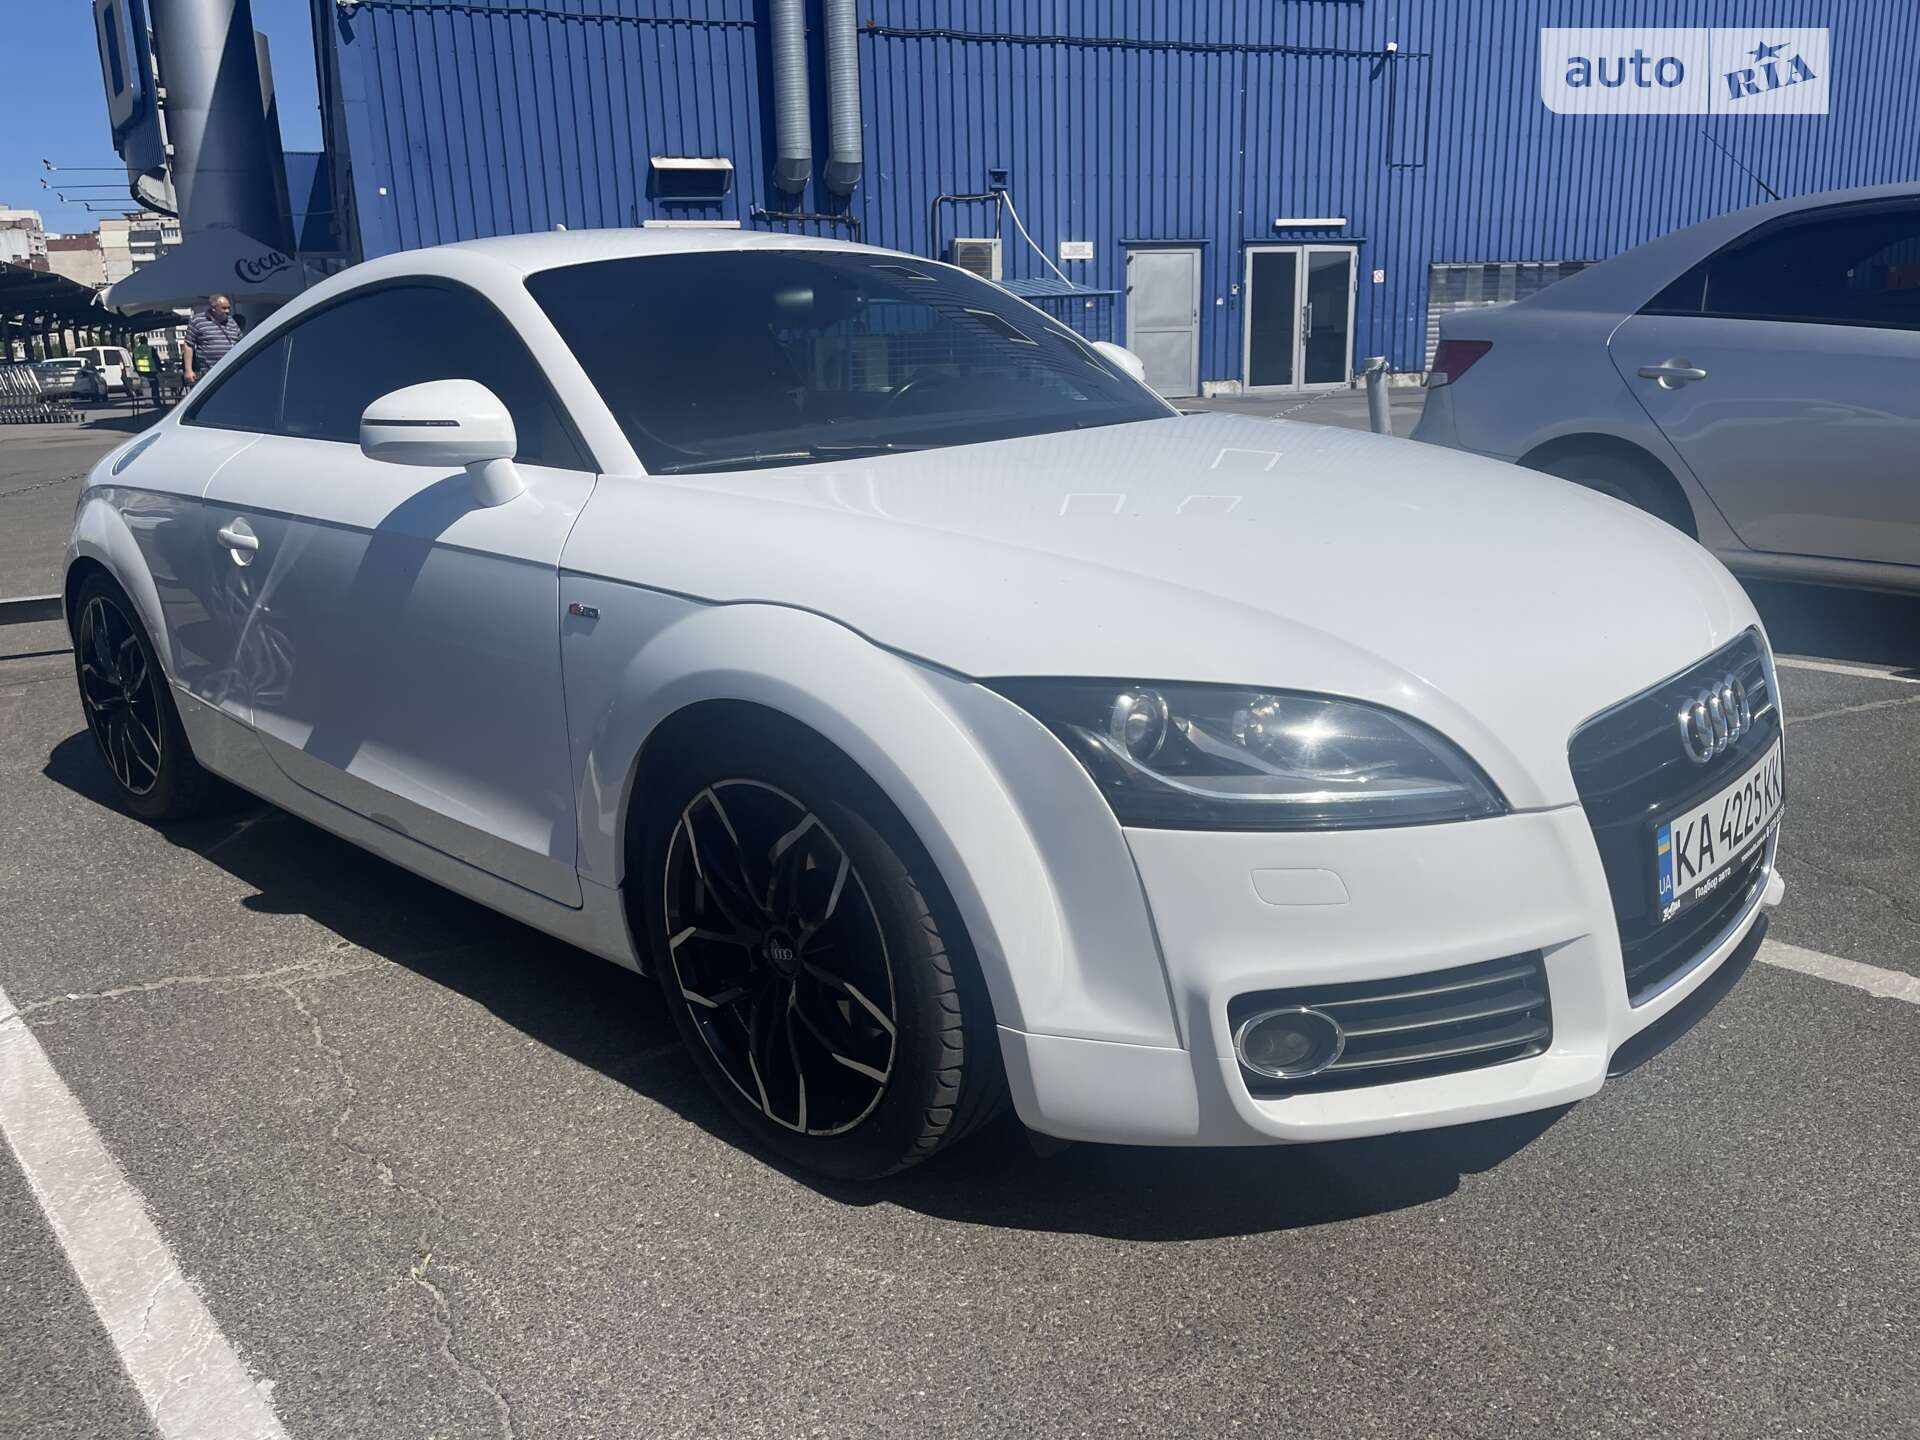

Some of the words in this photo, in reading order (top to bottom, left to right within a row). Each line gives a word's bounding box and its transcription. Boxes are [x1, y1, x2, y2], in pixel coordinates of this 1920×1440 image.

[235, 252, 295, 283] Coca
[1675, 812, 1715, 887] KA
[1720, 771, 1762, 851] 4225
[1764, 747, 1780, 816] KK
[1659, 873, 1672, 895] UA
